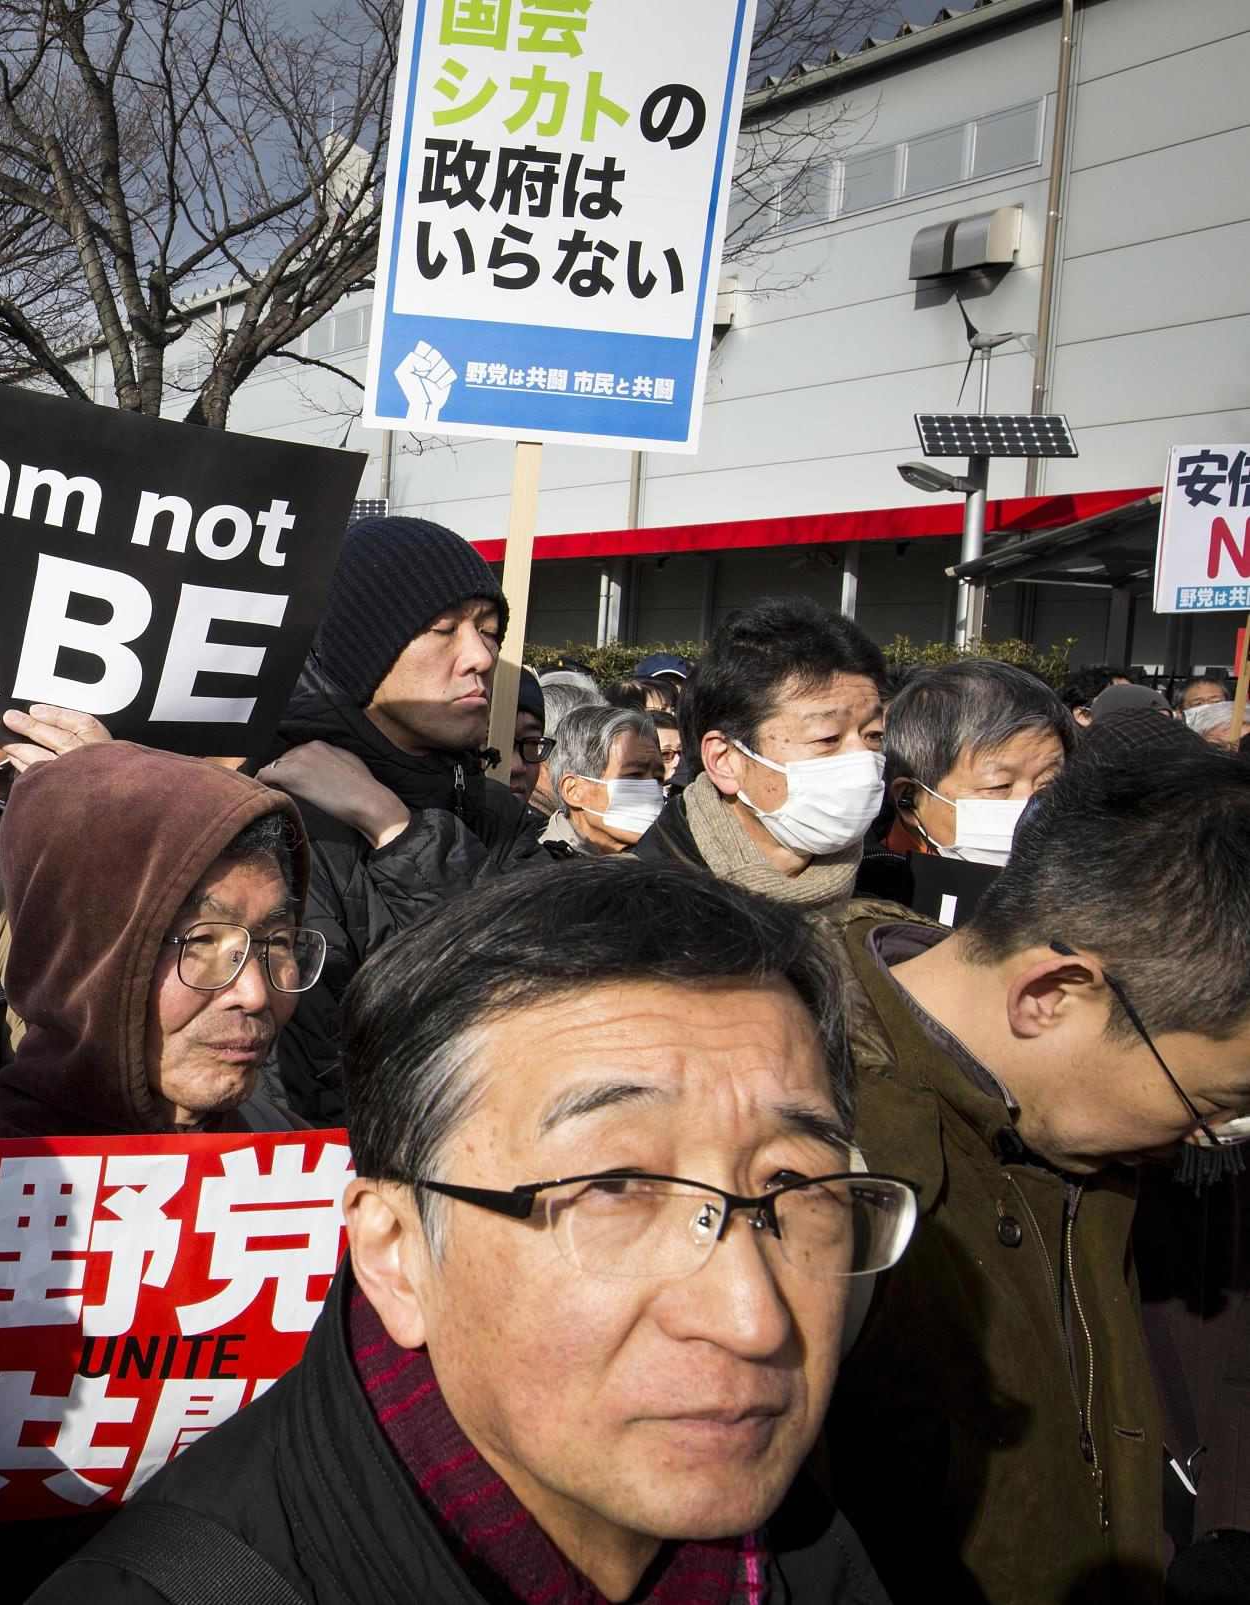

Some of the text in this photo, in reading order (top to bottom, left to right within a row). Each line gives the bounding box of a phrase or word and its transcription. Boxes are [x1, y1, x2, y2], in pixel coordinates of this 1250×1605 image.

[439, 0, 593, 58] 国会
[431, 57, 707, 151] シカトの
[418, 137, 626, 219] 政府は
[416, 221, 685, 299] いらない
[465, 361, 675, 401] 野党は共闘 市民と共闘
[131, 490, 296, 567] not
[1179, 586, 1250, 608] 野党は共
[79, 1333, 246, 1380] UNITE
